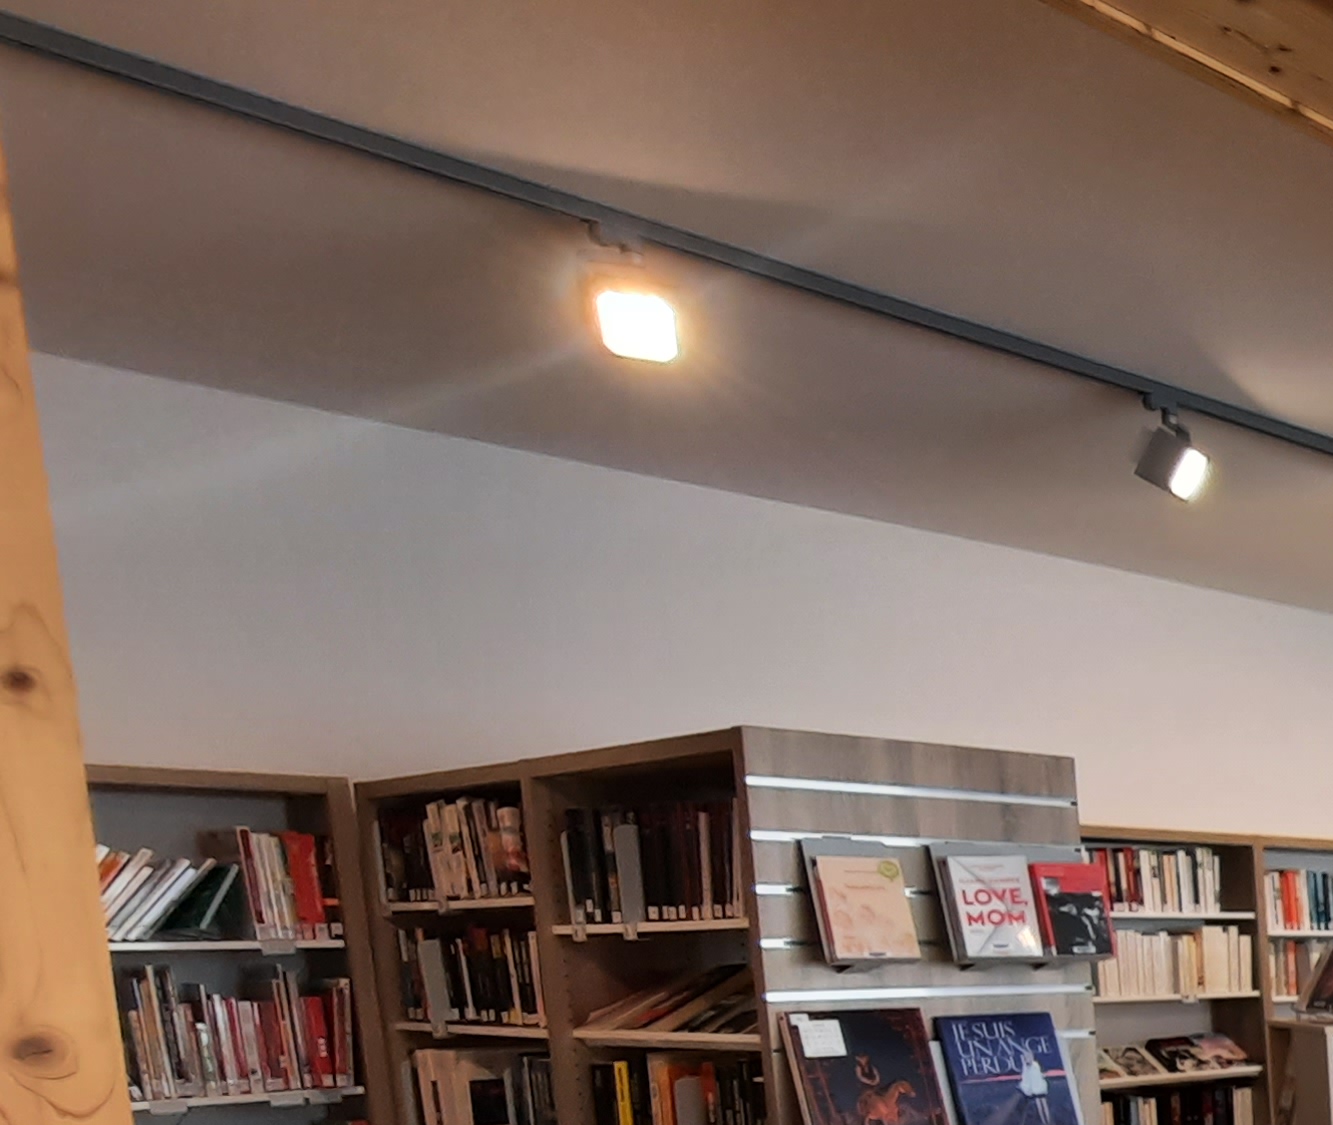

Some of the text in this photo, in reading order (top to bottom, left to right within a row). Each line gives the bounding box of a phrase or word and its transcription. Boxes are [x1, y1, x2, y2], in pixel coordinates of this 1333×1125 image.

[961, 888, 1029, 906] LOVE,
[965, 909, 1026, 927] MOM
[971, 1020, 1016, 1040] SUIS
[996, 1035, 1053, 1056] ANGE
[960, 1053, 1025, 1076] PERDU
